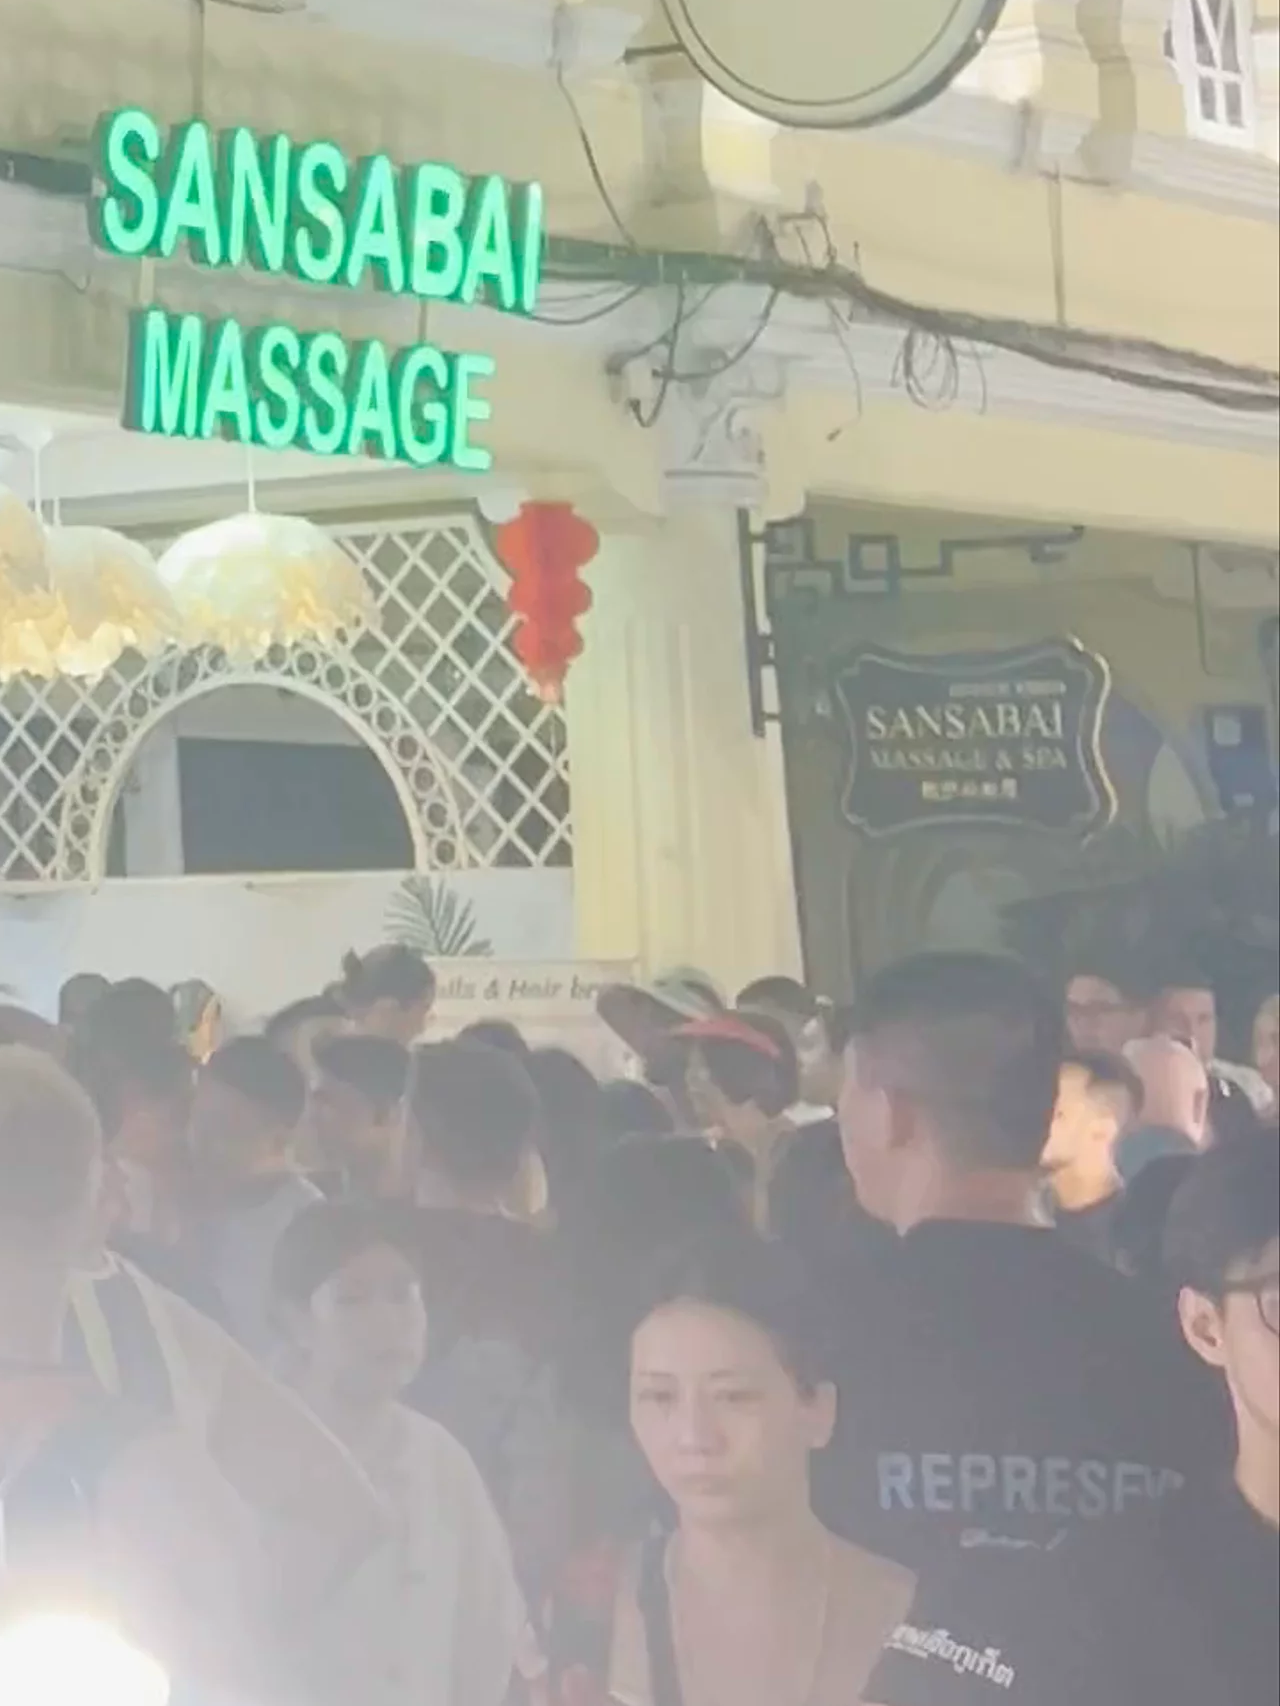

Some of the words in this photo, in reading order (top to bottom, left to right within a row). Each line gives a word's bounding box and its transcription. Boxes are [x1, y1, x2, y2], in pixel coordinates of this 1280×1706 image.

[100, 108, 544, 316] SANSABAI
[140, 308, 496, 471] MASSAGE
[866, 701, 1064, 741] SANSABAI
